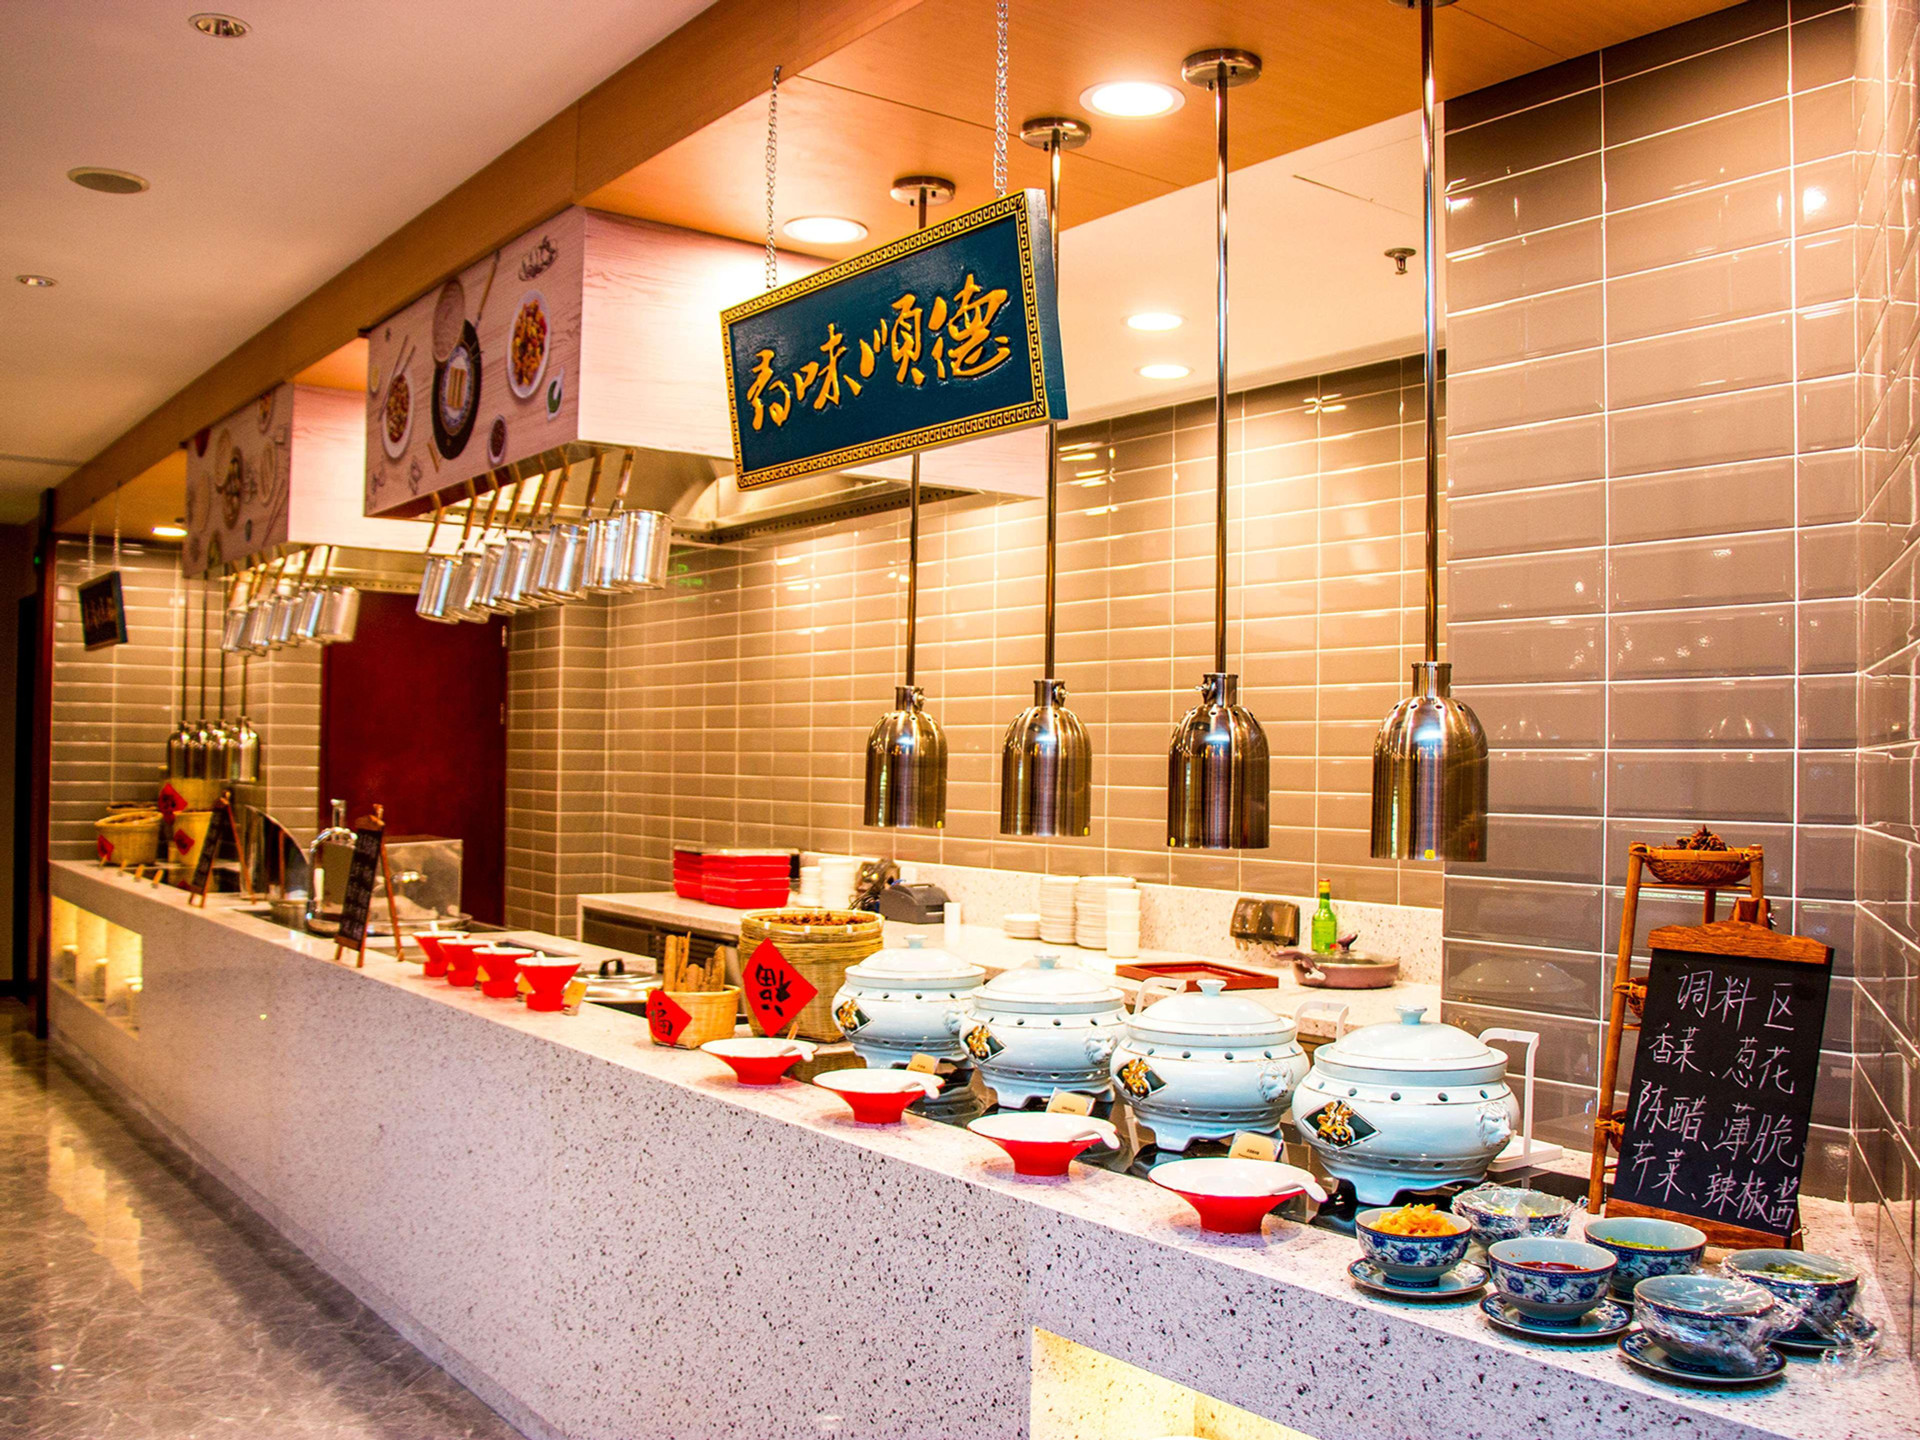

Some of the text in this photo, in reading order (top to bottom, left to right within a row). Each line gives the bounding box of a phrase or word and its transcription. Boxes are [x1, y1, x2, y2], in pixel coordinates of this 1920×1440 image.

[1677, 963, 1796, 1031] 调料区
[1648, 1022, 1796, 1095] 香菜、葱花
